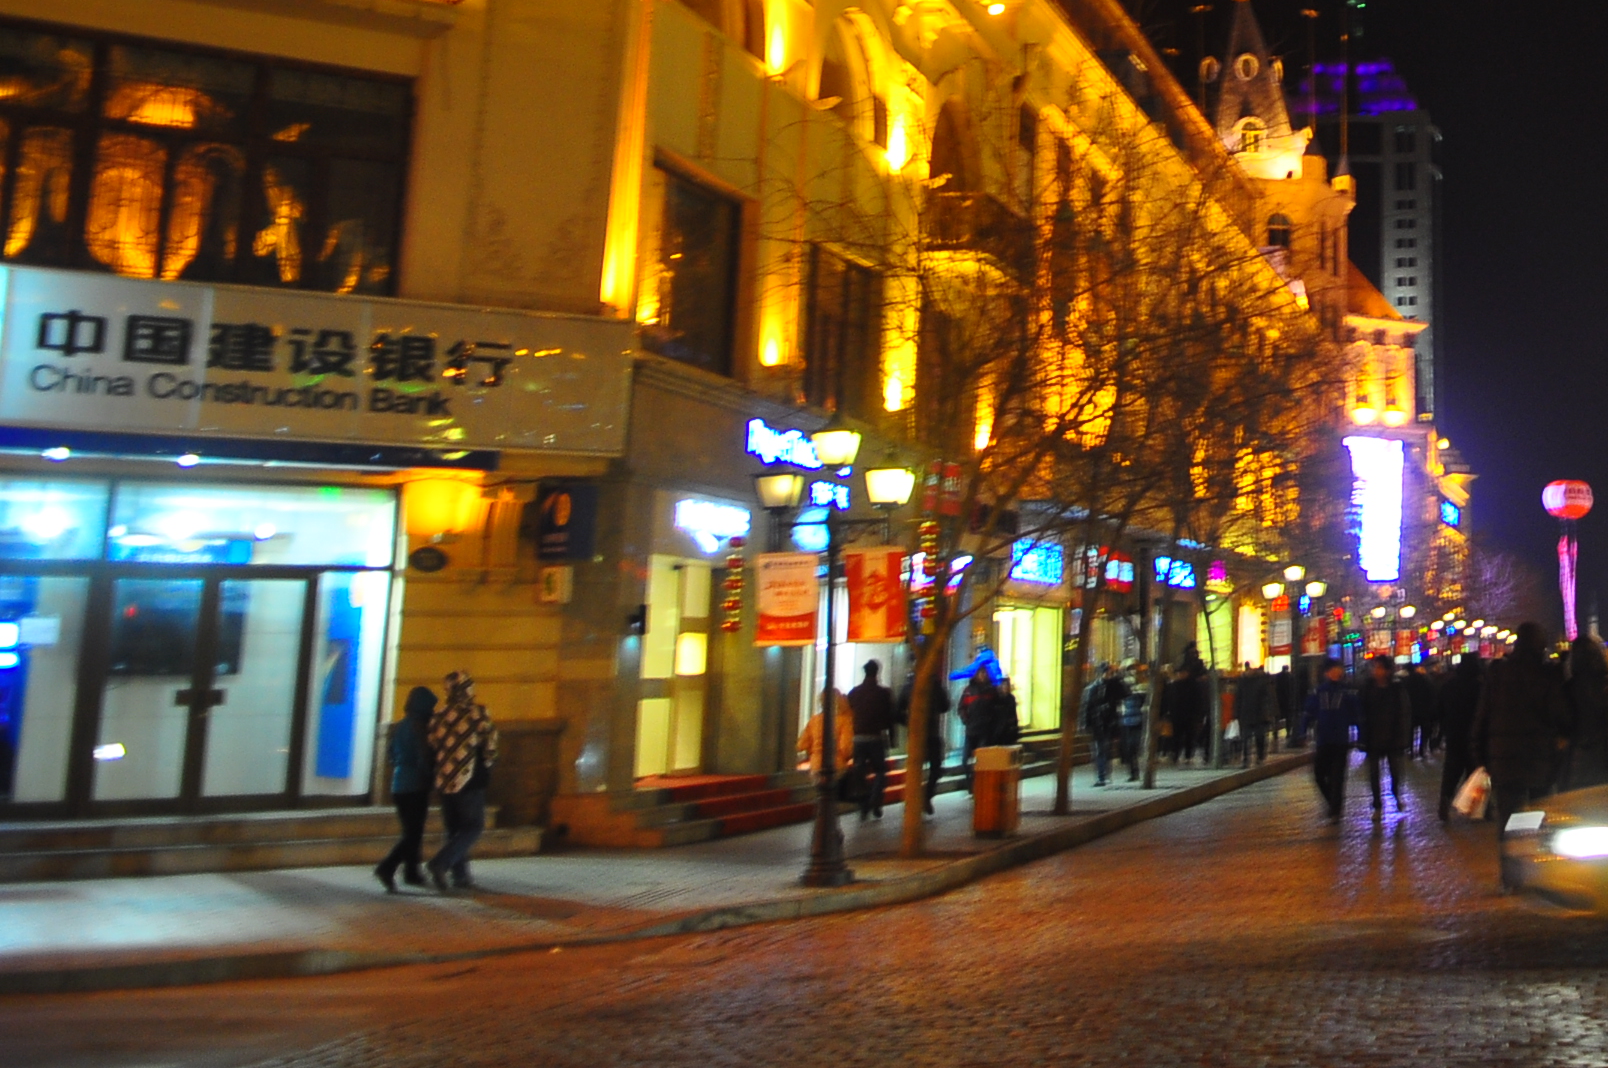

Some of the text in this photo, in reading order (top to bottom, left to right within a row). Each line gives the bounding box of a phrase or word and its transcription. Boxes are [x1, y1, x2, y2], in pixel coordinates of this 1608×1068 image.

[38, 309, 513, 386] 中国建设银行
[29, 363, 452, 416] China Construction Bank
